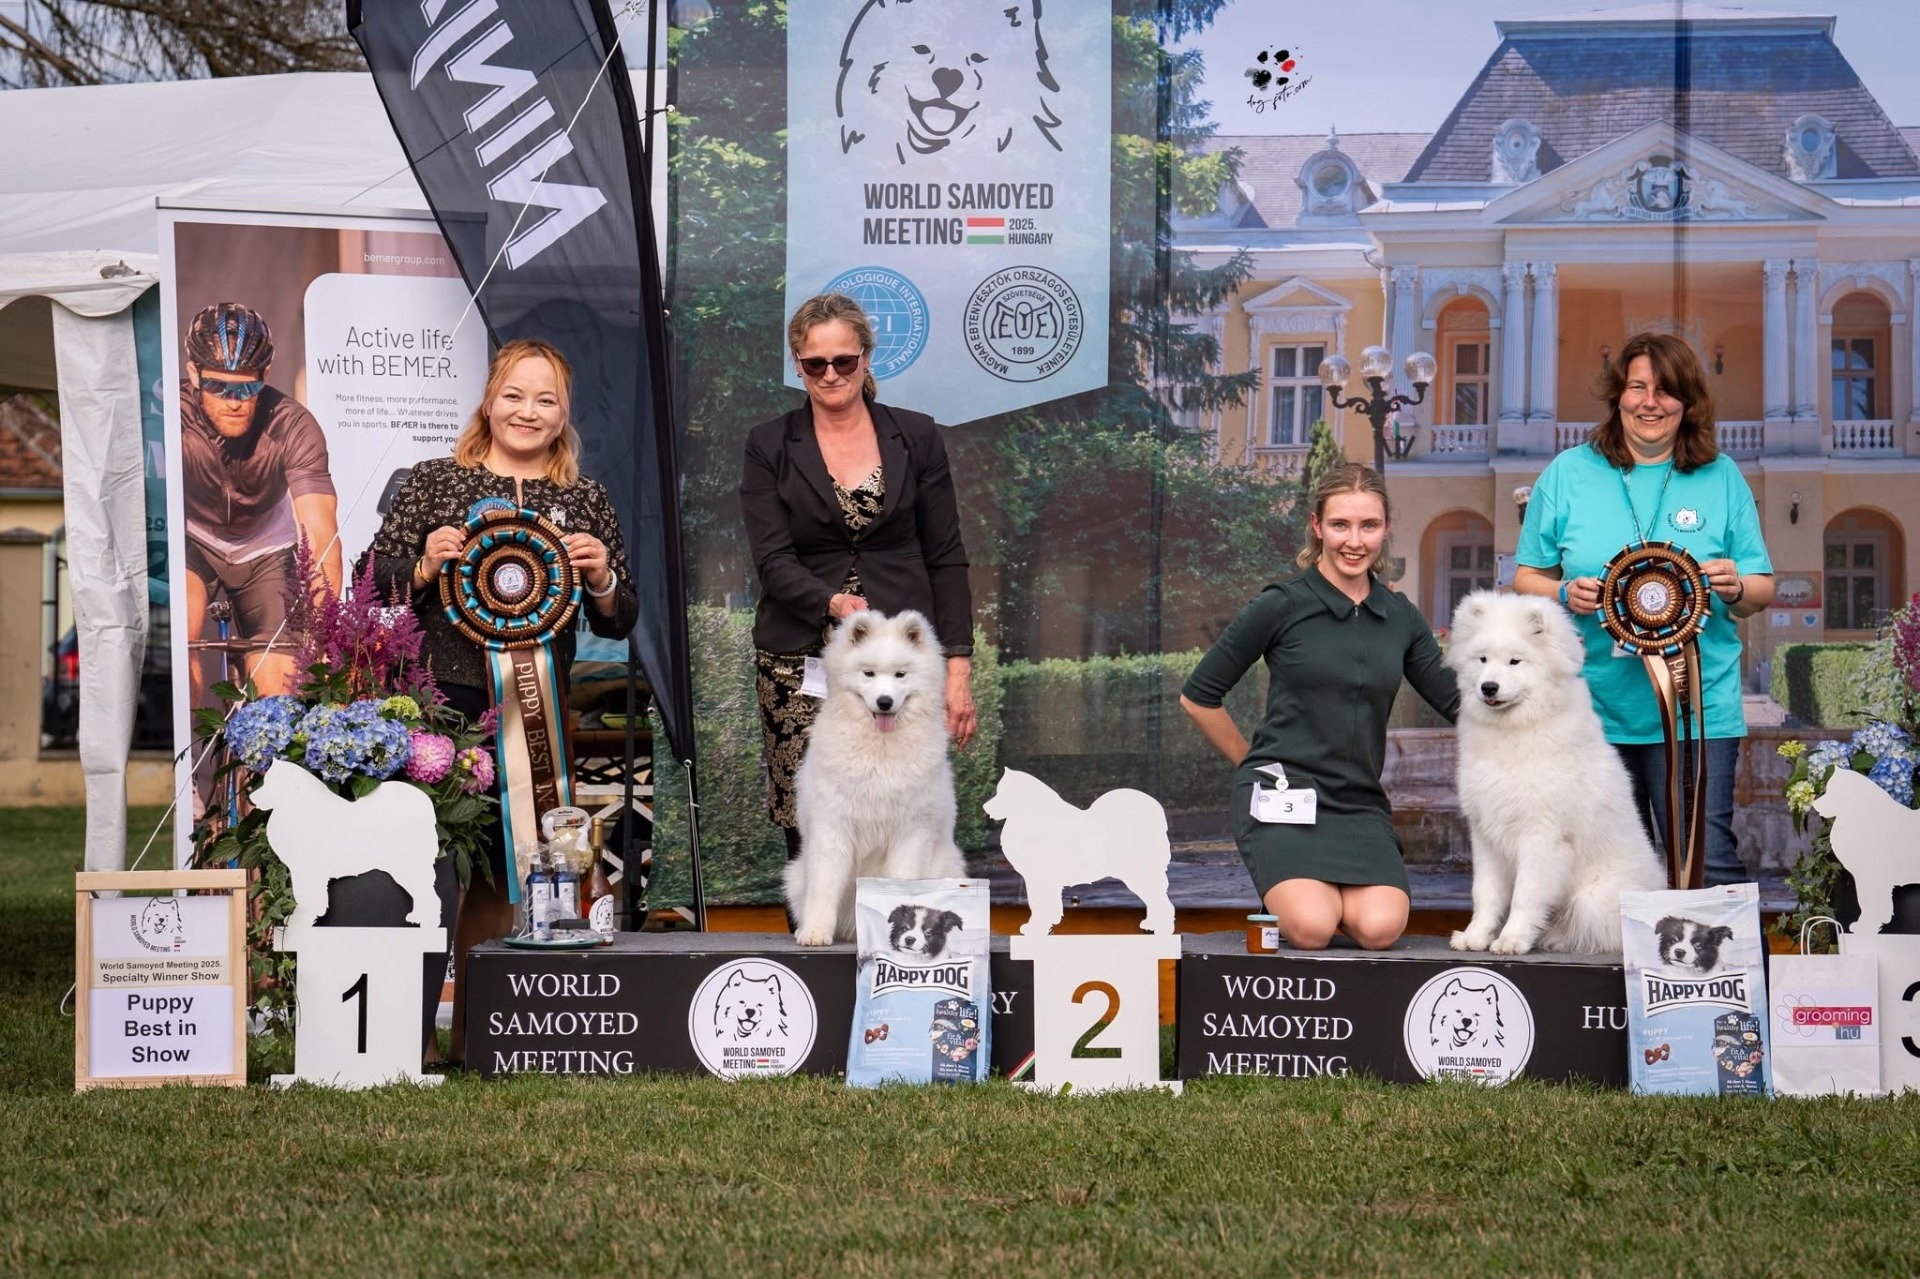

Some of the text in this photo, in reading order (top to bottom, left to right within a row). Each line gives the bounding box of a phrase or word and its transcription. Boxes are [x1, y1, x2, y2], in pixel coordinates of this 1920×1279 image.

[864, 183, 1054, 209] WORLD SAMOYED
[863, 217, 963, 245] MEETING
[1009, 218, 1037, 231] 2025.
[1008, 232, 1054, 245] HUNGARY
[363, 252, 445, 266] bemergroup.com
[1013, 271, 1067, 298] ORSZÁGOS
[1002, 289, 1046, 302] SZÖVETSÉGE
[835, 273, 923, 371] NOLOGIQUE INTERNATIONALE
[346, 326, 453, 351] Active life
[1037, 297, 1079, 374] EGYESÜLETEINEK
[974, 342, 1009, 374] MAGYAR
[1012, 346, 1034, 355] 1899
[317, 353, 458, 378] with BEMER.
[336, 394, 355, 402] More
[367, 407, 375, 415] of
[435, 409, 458, 417] drives
[338, 421, 352, 429] you
[352, 420, 360, 428] in
[361, 421, 389, 429] sports.
[420, 421, 427, 429] is
[428, 422, 449, 430] there
[450, 422, 459, 430] to
[412, 435, 443, 443] support
[526, 729, 553, 774] BEST
[1284, 802, 1293, 813] 3
[130, 914, 171, 953] WORLD SAMOYED MEETING
[100, 960, 222, 971] World Samoyed Meeting 2025.
[102, 972, 220, 984] Specialty Winner Show
[875, 963, 969, 989] HAPPY DOG
[507, 973, 621, 998] WORLD
[1222, 975, 1336, 1001] WORLD
[1647, 980, 1746, 1005] HAPPY DOG
[127, 994, 194, 1014] Puppy
[342, 974, 368, 1054] 1
[959, 1007, 978, 1020] life!
[1071, 980, 1122, 1058] 2
[1796, 1007, 1870, 1024] grooming
[124, 1019, 197, 1037] Best in
[488, 1011, 639, 1036] SAMOYED
[1203, 1012, 1353, 1041] SAMOYED
[1643, 1027, 1669, 1036] PUPPY
[1740, 1020, 1759, 1032] life!
[1841, 1026, 1859, 1039] hu
[132, 1046, 190, 1063] Show
[723, 1047, 786, 1057] WORLD SAMOYED
[493, 1050, 635, 1075] MEETING
[723, 1059, 756, 1069] MEETING
[1207, 1051, 1348, 1079] MEETING
[1438, 1056, 1502, 1067] WORLD SAMOYED
